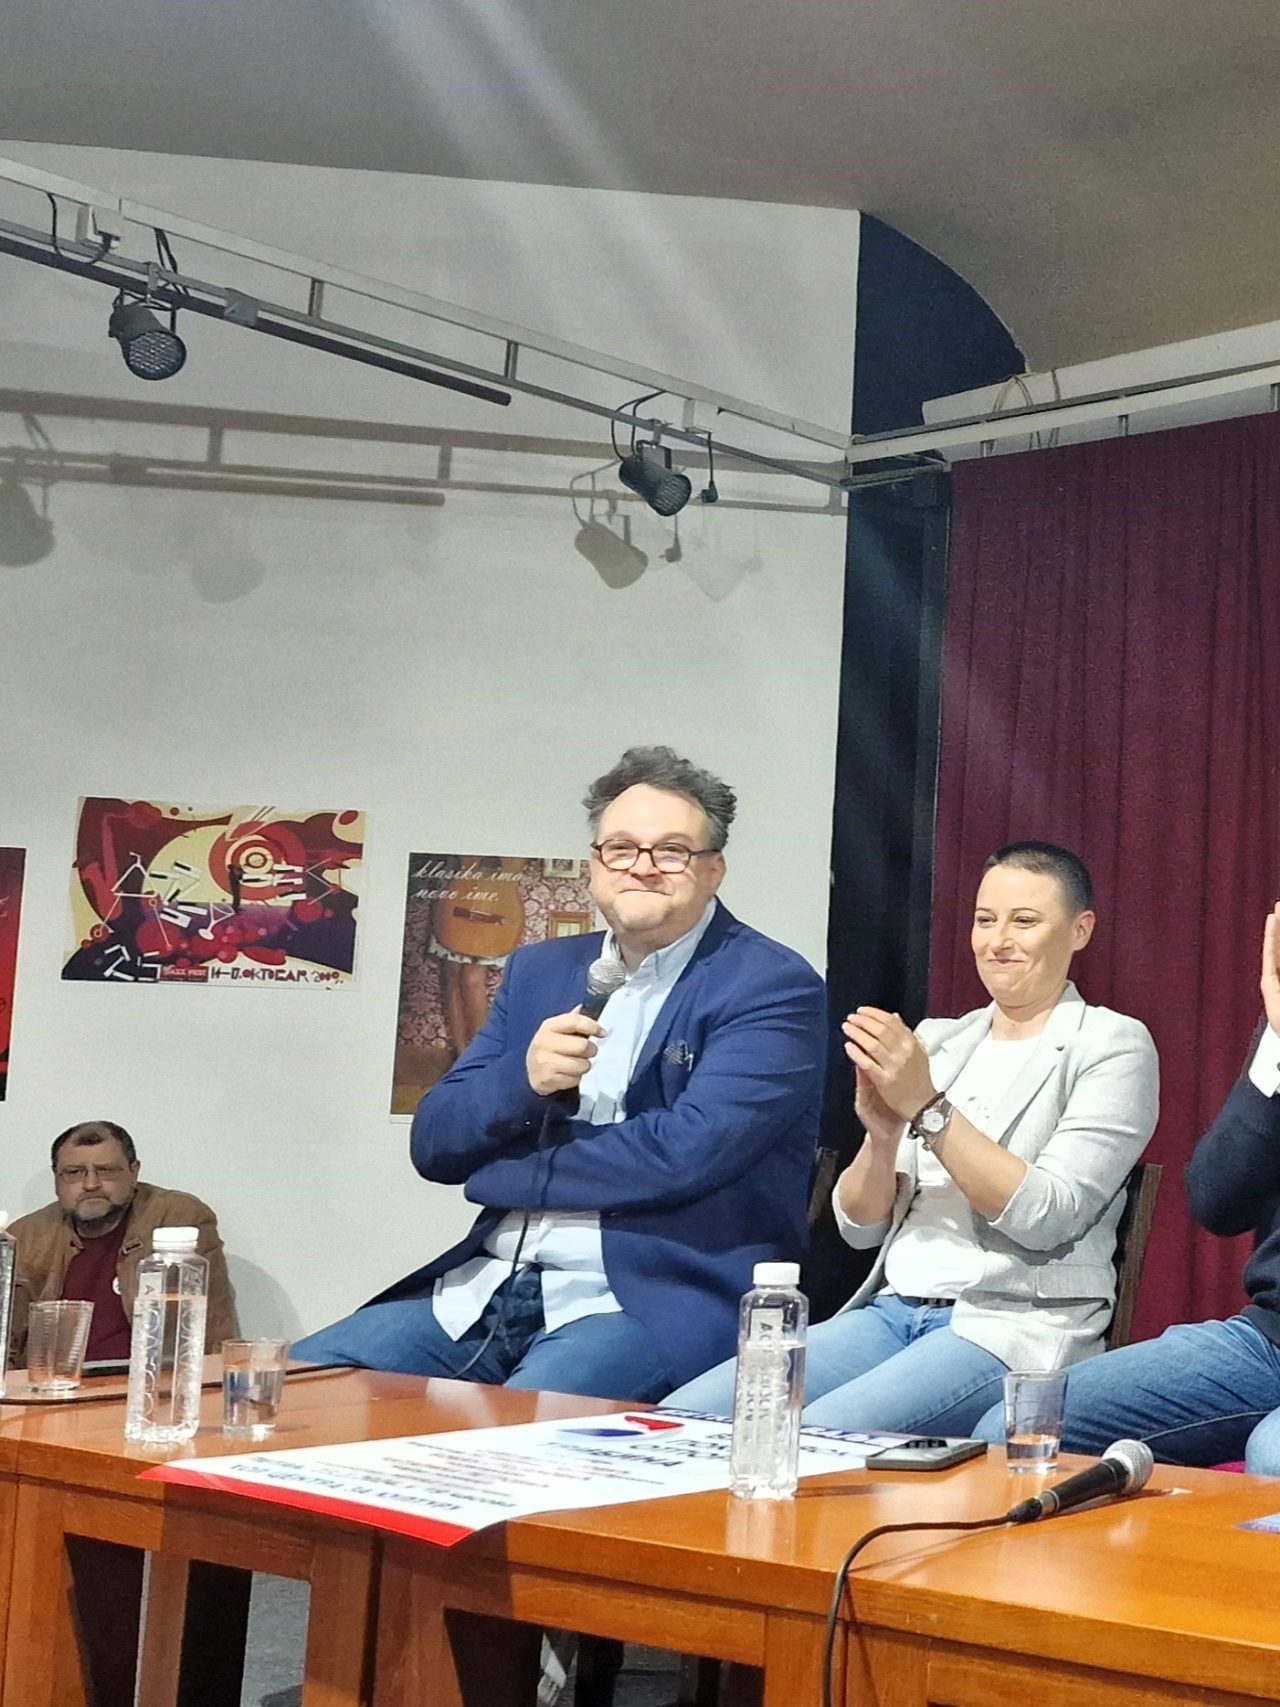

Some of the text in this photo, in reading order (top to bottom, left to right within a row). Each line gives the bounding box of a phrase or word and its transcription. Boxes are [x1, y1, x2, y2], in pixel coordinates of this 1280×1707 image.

[412, 860, 522, 881] klasika ima
[410, 888, 458, 900] novo
